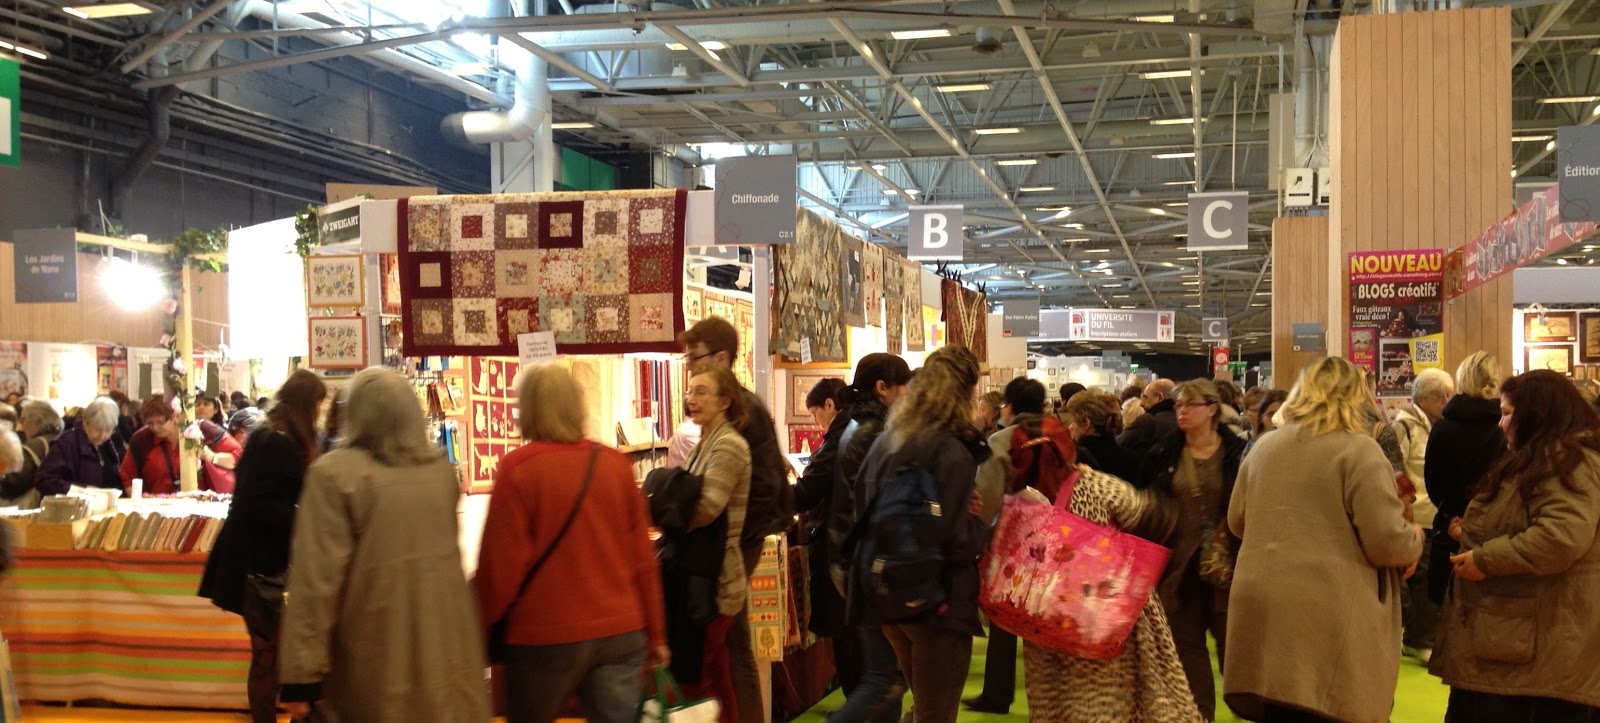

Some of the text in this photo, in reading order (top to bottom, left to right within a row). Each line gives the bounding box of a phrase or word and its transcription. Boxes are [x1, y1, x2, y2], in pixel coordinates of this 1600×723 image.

[731, 193, 779, 204] Chiffonade
[329, 215, 359, 232] ZWEIGART
[1202, 199, 1233, 239] C
[923, 213, 949, 248] B
[25, 254, 65, 264] Les Jardins
[1351, 253, 1442, 273] NOUVEAU
[31, 265, 40, 273] de
[1358, 283, 1395, 299] BLOGS
[1398, 282, 1437, 298] créatifs
[1368, 305, 1392, 314] gâteaux
[1091, 313, 1134, 322] UNIVERSITE
[1371, 312, 1386, 320] déco
[1091, 321, 1114, 329] DU FIL
[1208, 320, 1221, 338] C
[1091, 330, 1119, 339] Inscriptions
